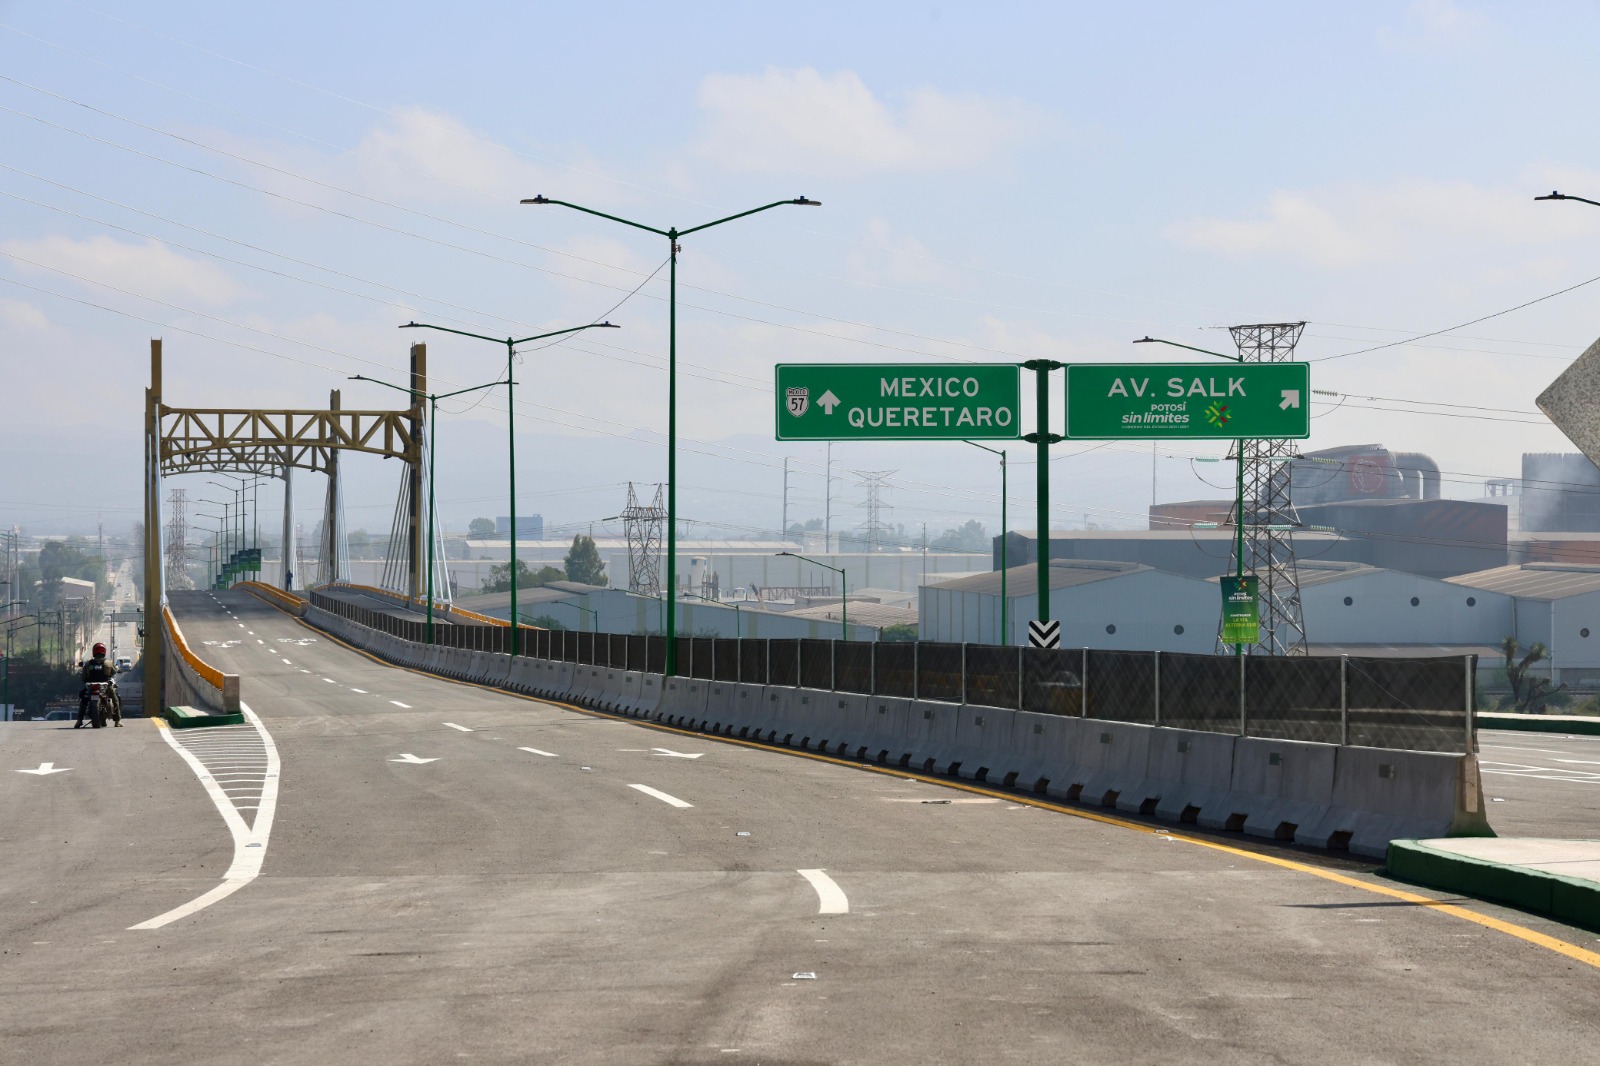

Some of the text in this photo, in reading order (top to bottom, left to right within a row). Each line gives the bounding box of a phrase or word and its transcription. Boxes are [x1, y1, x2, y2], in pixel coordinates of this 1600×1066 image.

[880, 377, 979, 397] MEXICO
[1107, 377, 1247, 398] AV. SALK
[791, 397, 805, 411] 57
[847, 407, 1012, 428] QUERETARO
[1121, 411, 1142, 423] sin
